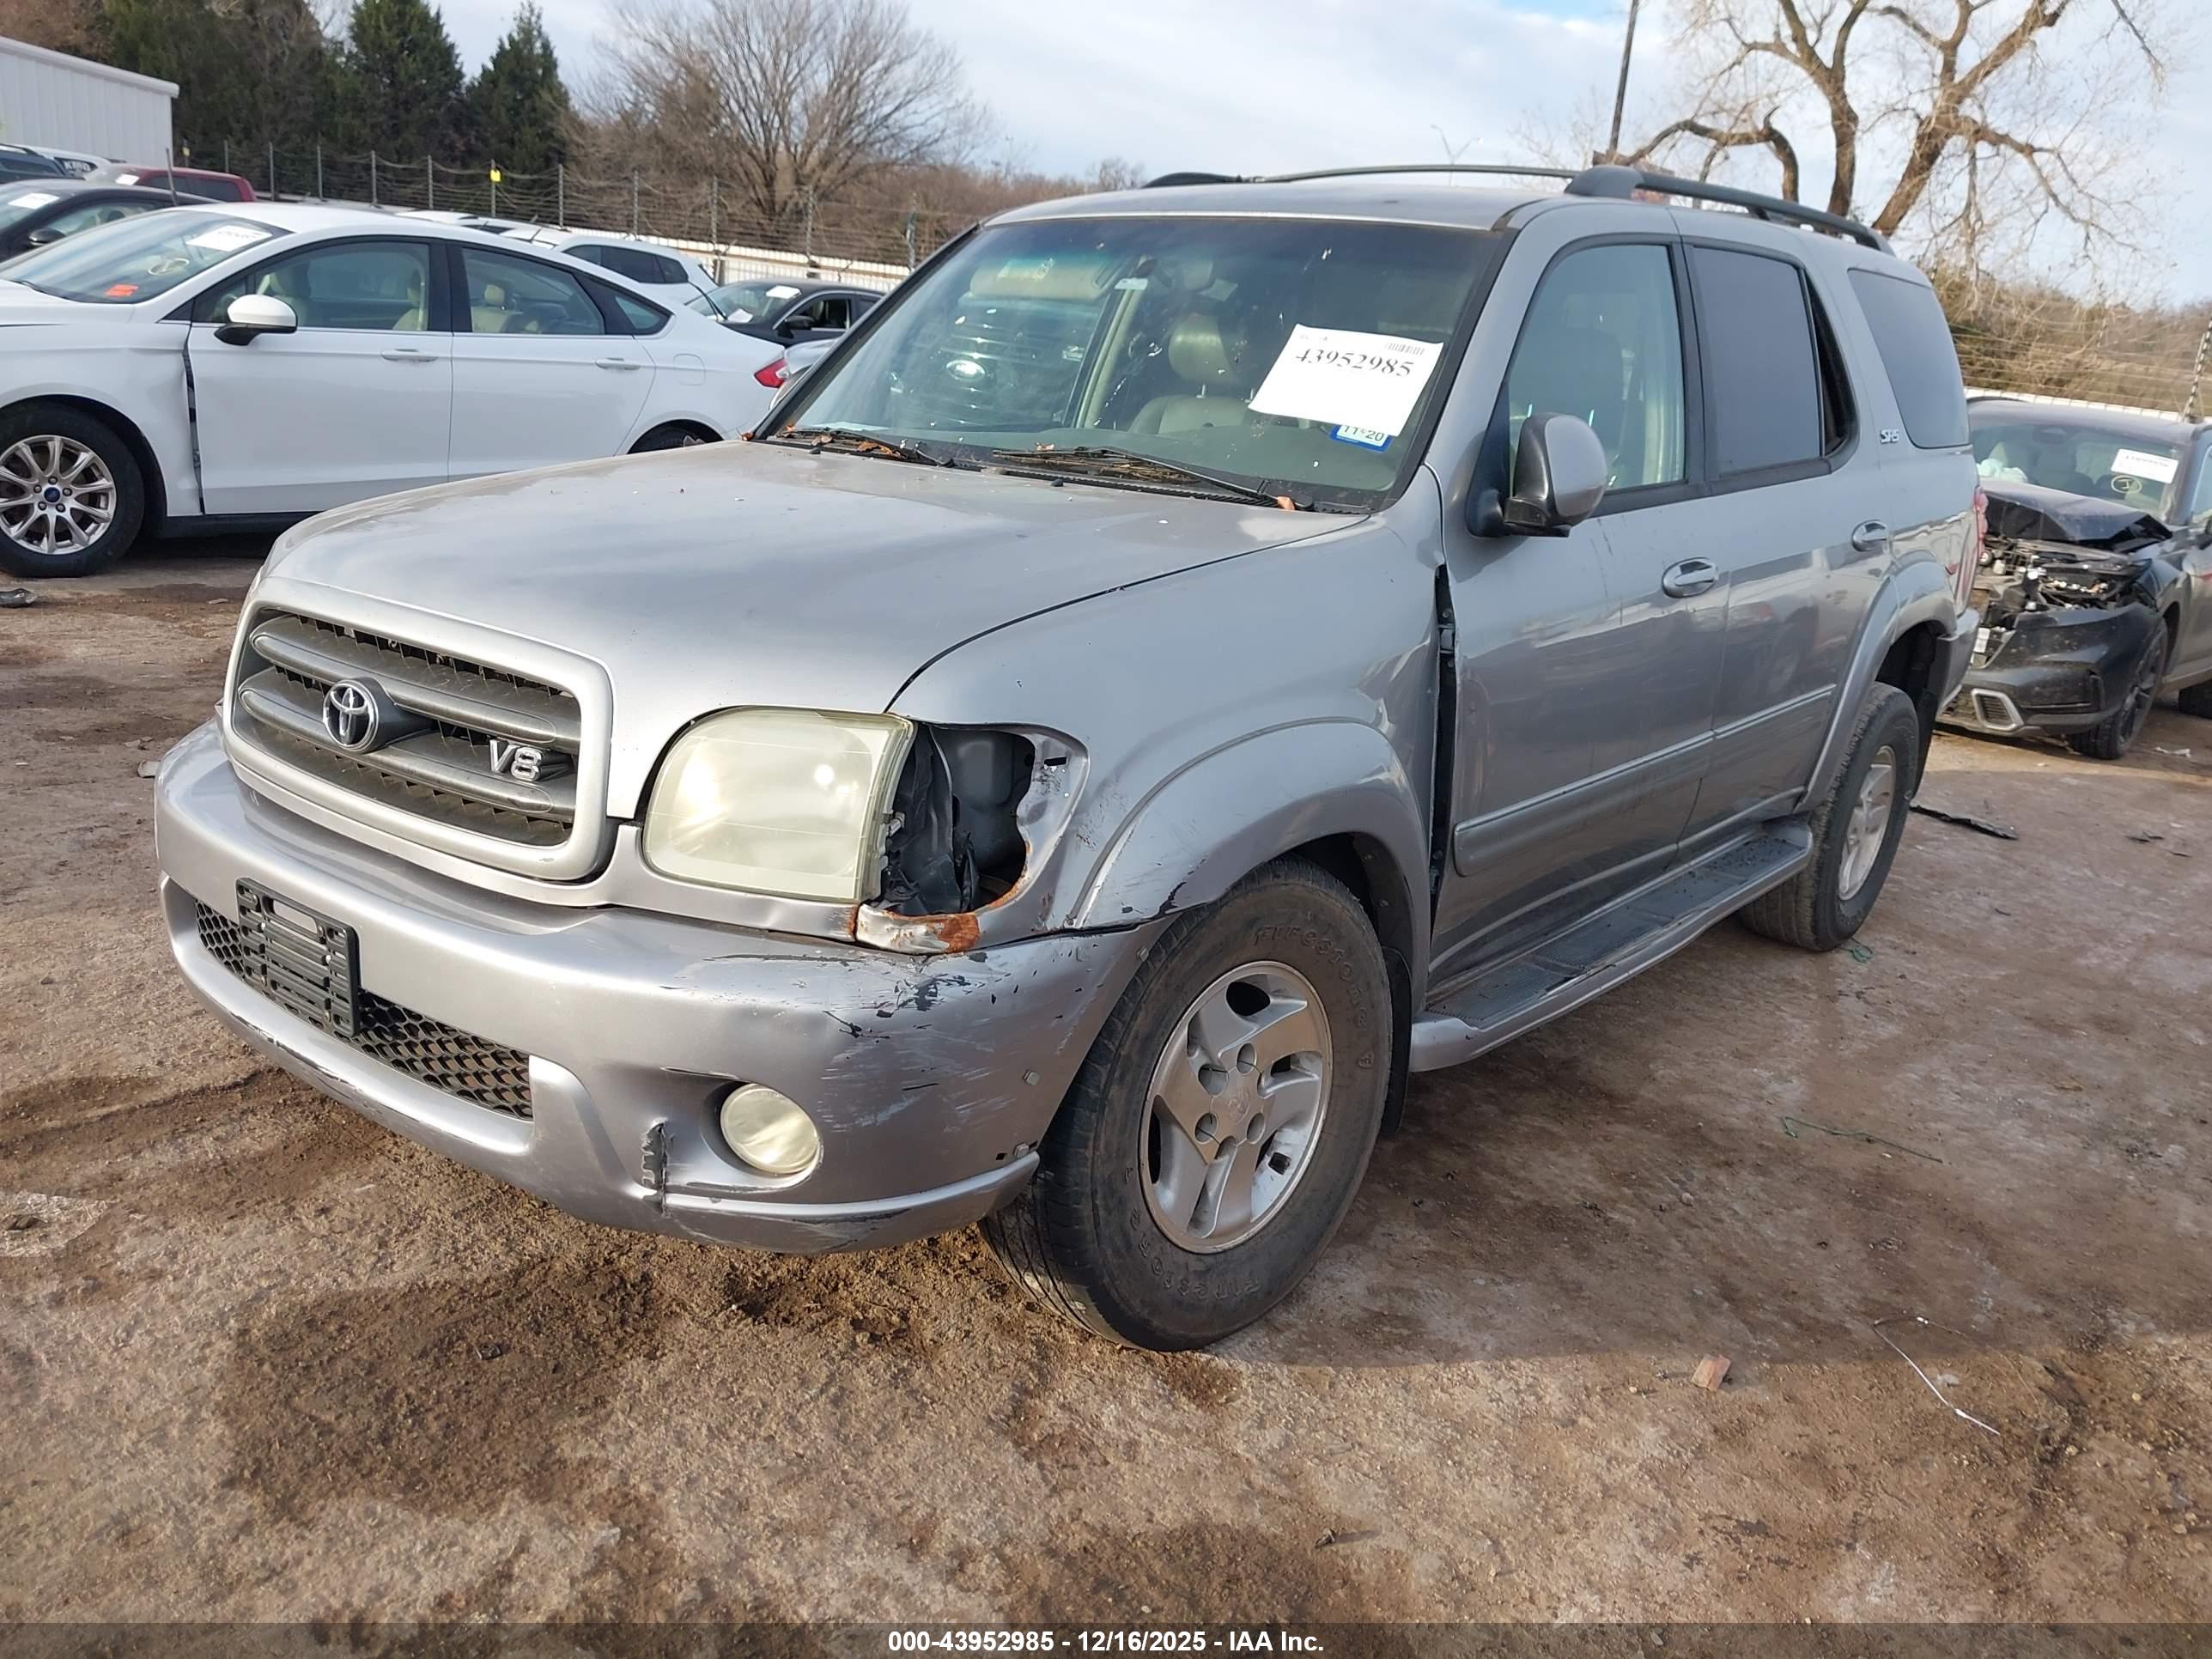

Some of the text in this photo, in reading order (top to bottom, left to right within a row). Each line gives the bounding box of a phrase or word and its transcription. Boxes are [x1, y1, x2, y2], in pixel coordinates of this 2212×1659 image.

[1296, 348, 1415, 377] 43952985
[1365, 429, 1384, 441] 20
[489, 739, 543, 782] V8
